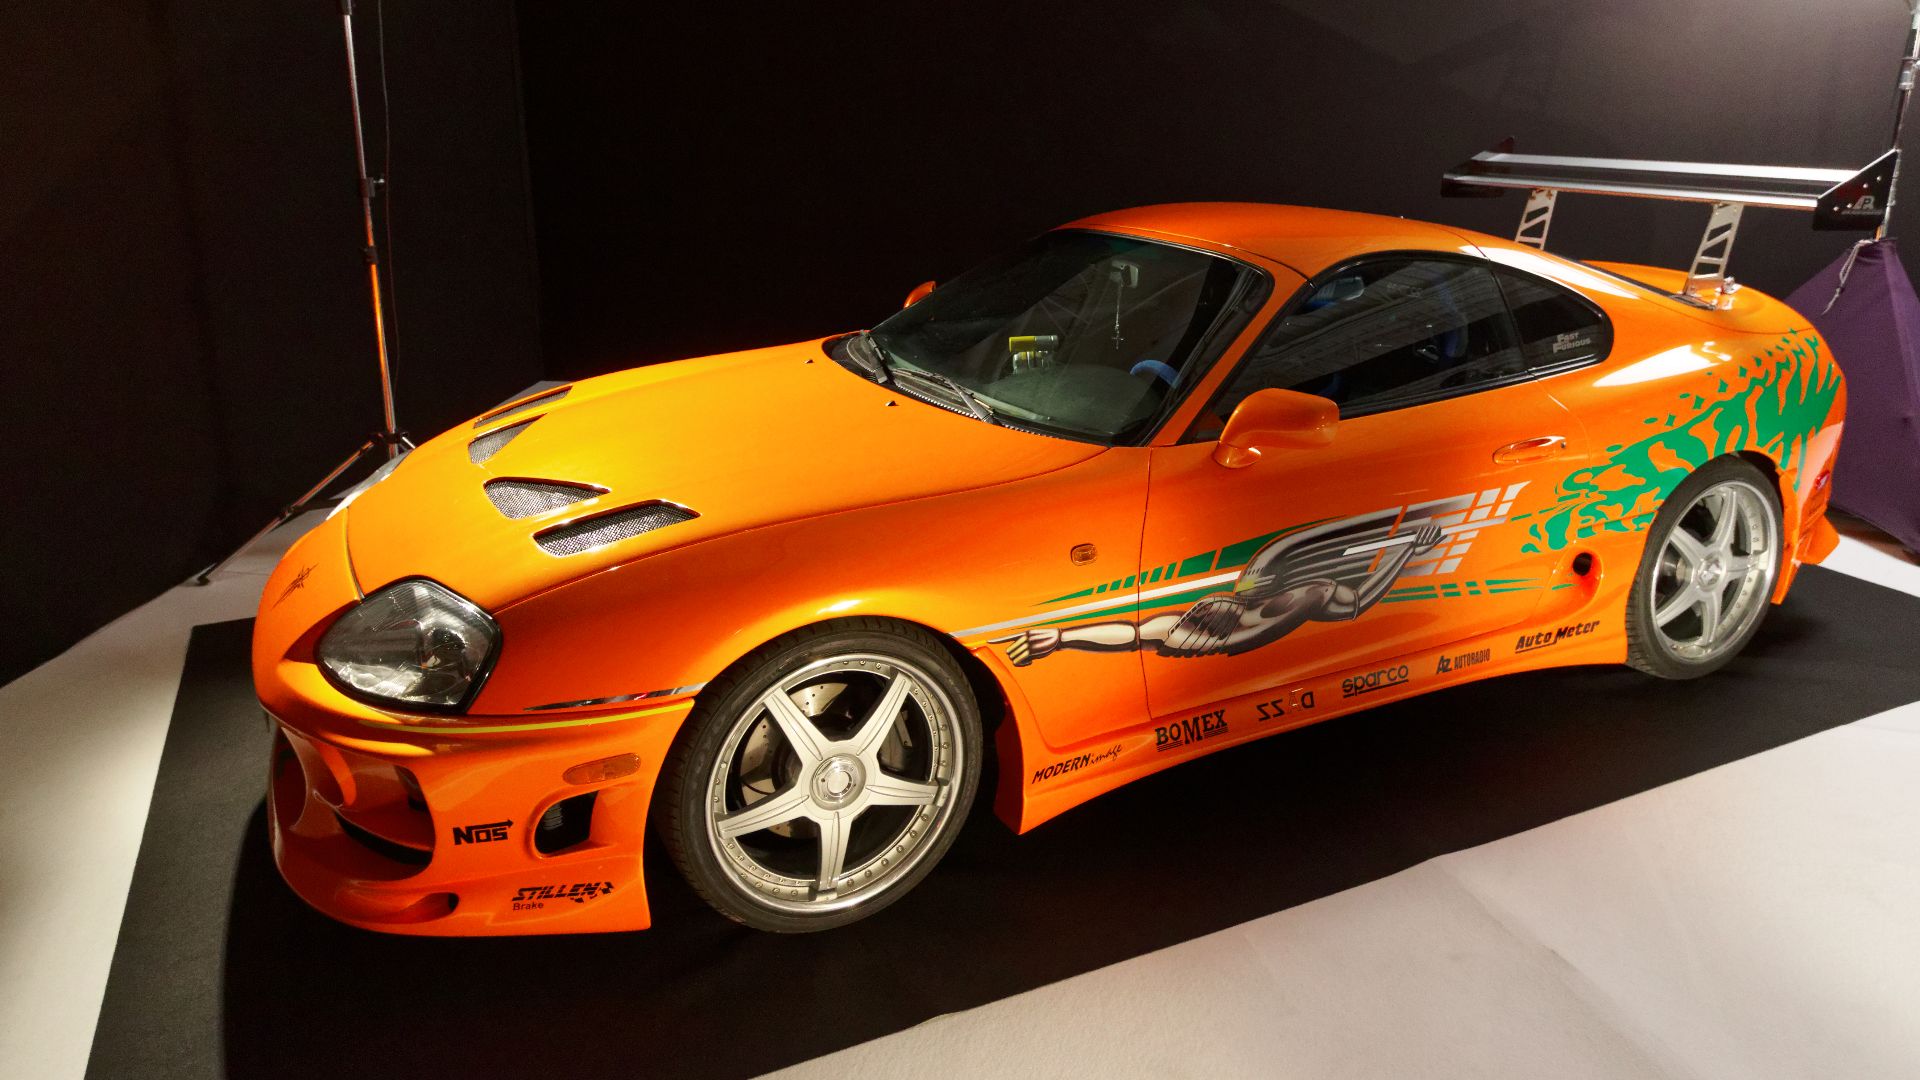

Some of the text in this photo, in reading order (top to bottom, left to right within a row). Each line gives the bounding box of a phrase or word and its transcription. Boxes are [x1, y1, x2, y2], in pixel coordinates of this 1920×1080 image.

[1454, 648, 1491, 670] AUTORADIO
[1342, 664, 1409, 696] sparco
[1155, 709, 1228, 746] BOMEX
[453, 824, 509, 846] NOS
[512, 882, 601, 902] STILLEN
[512, 901, 544, 911] Brake
